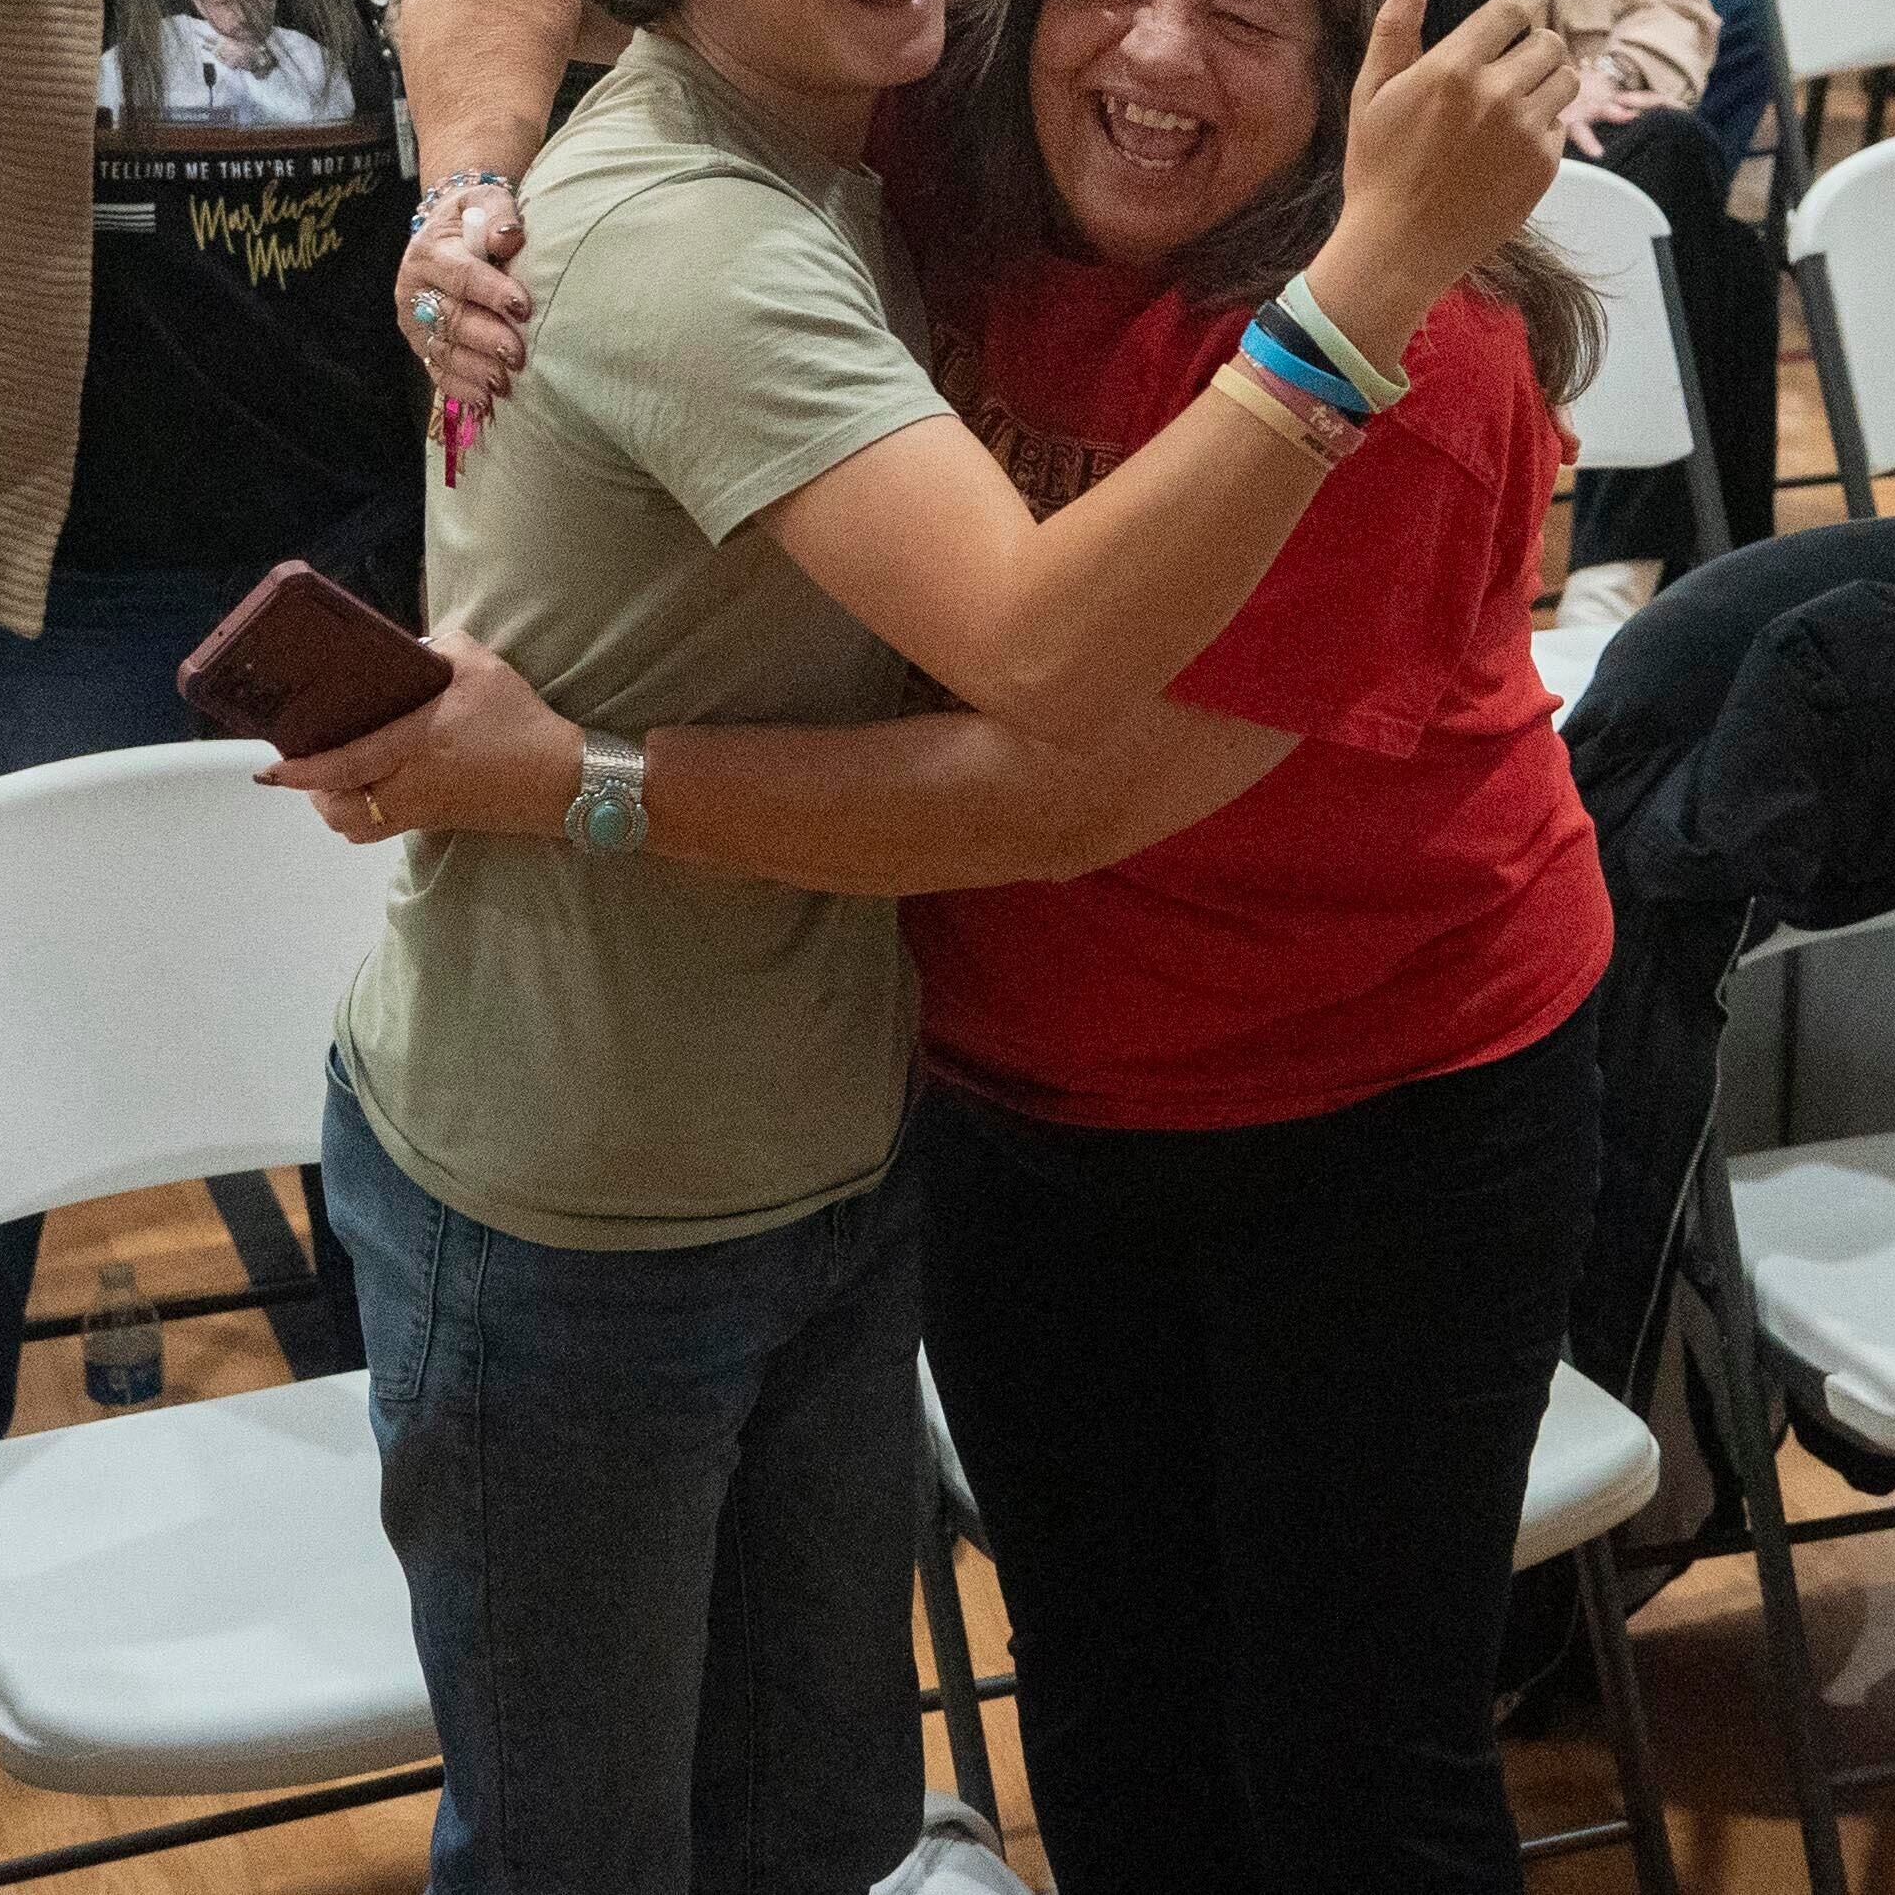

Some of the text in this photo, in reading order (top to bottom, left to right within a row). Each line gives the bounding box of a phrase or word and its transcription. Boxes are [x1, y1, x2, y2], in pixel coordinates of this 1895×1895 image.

[99, 160, 177, 180] TELLING
[185, 160, 210, 180] ME
[219, 158, 296, 179] THEY'RE
[311, 155, 346, 175] NOT
